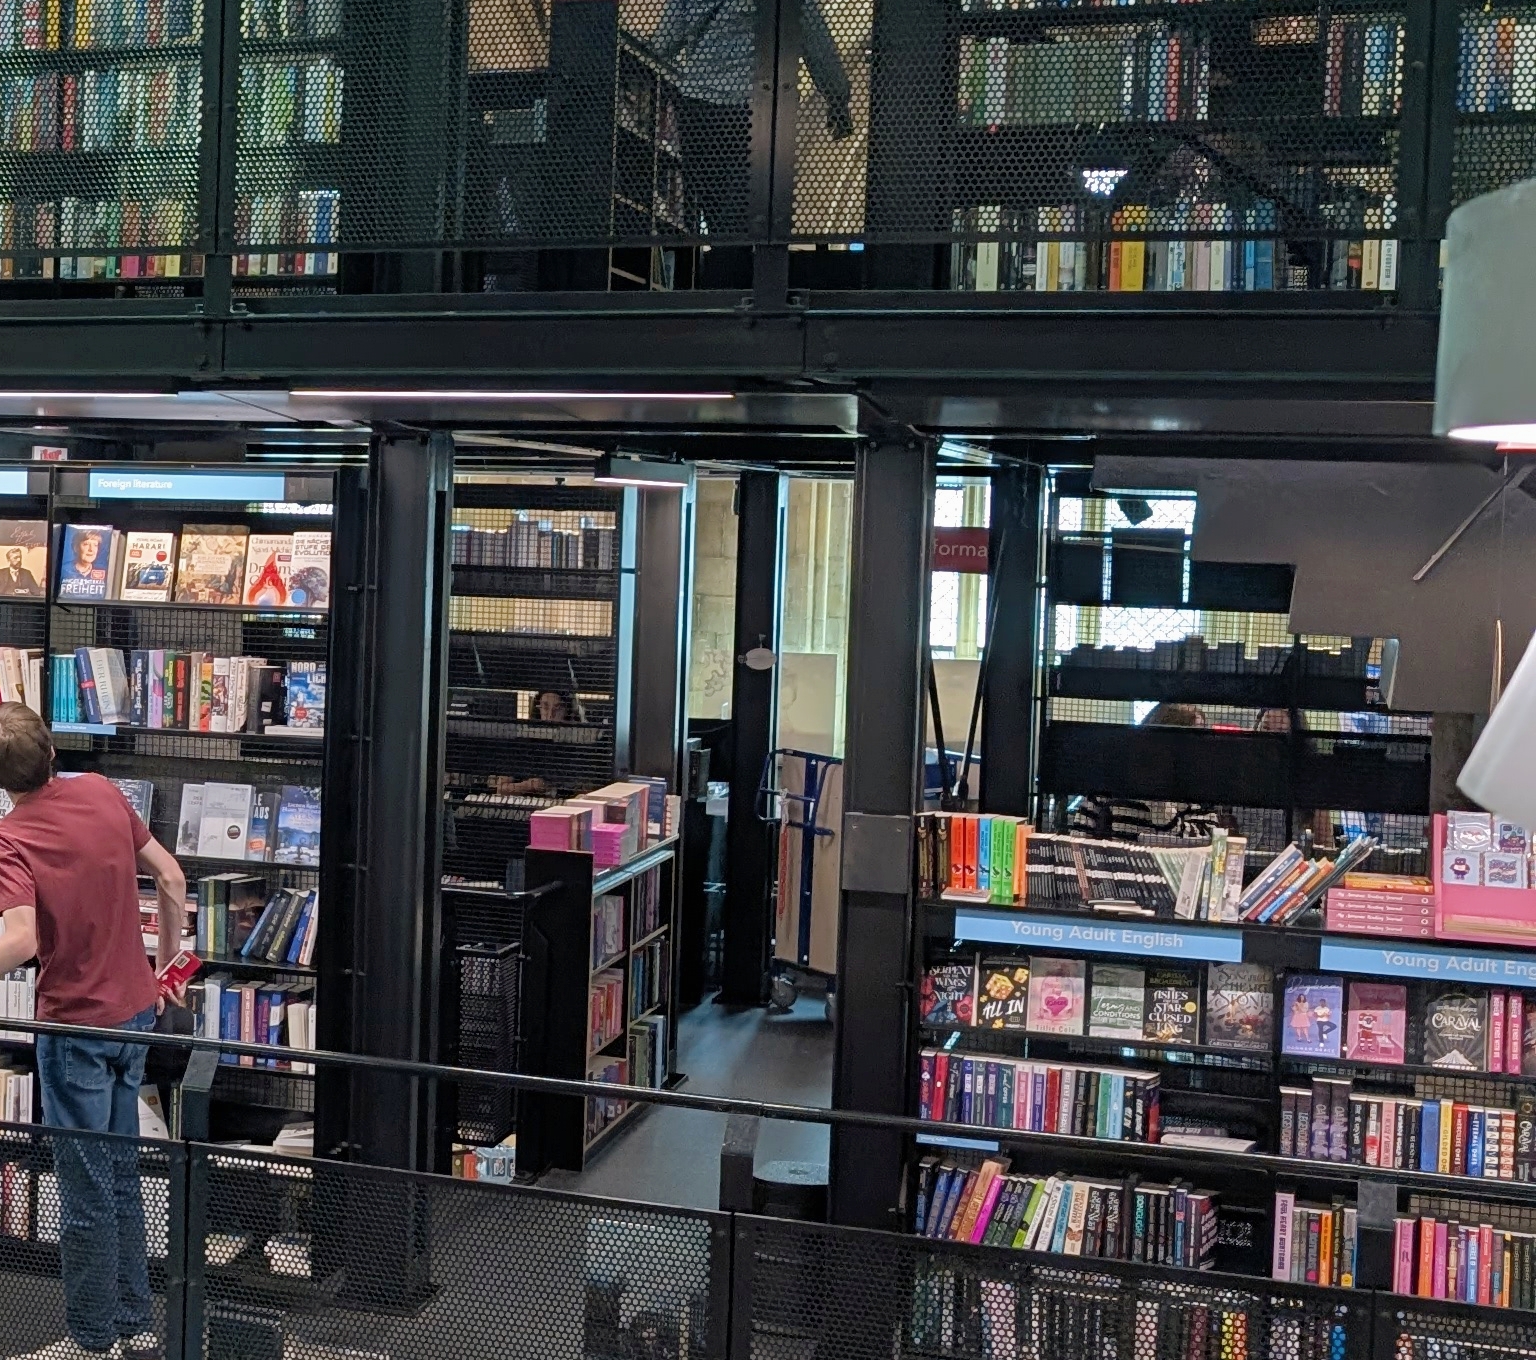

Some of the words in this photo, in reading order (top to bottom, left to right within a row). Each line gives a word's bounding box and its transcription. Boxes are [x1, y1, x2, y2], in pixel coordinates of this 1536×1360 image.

[98, 478, 129, 491] Foreign
[132, 542, 166, 550] HARARI
[61, 583, 105, 595] FREIHEIT
[292, 662, 316, 672] NORD
[254, 806, 269, 819] AUS
[1011, 920, 1063, 941] Young
[1069, 926, 1116, 942] Adult
[1122, 930, 1183, 949] English
[1382, 950, 1440, 973] Young
[1446, 955, 1497, 974] Adult
[935, 977, 966, 989] WINGS
[934, 990, 965, 1002] NIGHT
[1154, 989, 1189, 1001] ASHES
[1217, 991, 1272, 1009] STONE
[982, 1002, 1004, 1018] ALL
[1006, 999, 1024, 1015] IN
[1153, 1002, 1186, 1014] STAR-
[1093, 1010, 1141, 1019] CONDITIONS
[1149, 1013, 1192, 1024] CURSED
[1432, 1012, 1481, 1031] CARAVAL
[1035, 1024, 1055, 1033] Tillie
[1059, 1025, 1076, 1034] Cole
[1518, 1121, 1531, 1155] CARAVAL
